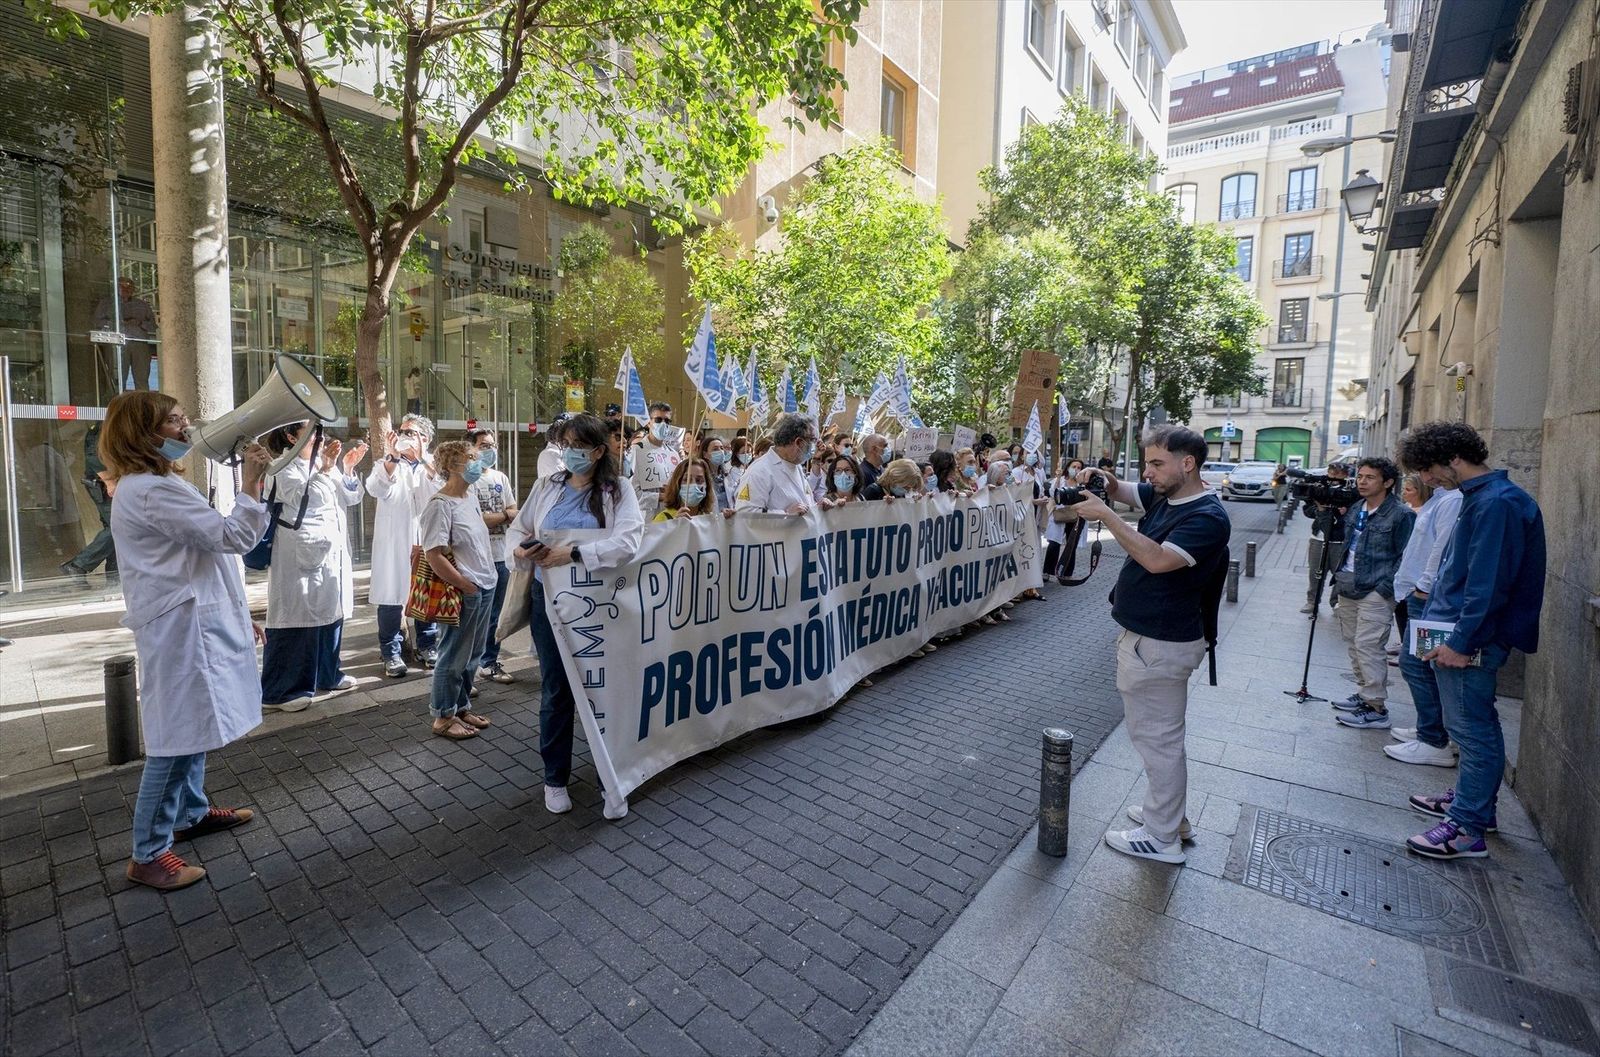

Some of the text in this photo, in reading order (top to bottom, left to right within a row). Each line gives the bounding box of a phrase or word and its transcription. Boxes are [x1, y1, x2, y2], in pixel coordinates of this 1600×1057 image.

[443, 271, 555, 306] de Sanidad
[645, 467, 660, 482] 24
[647, 452, 667, 463] STOP
[638, 549, 721, 644] POR
[729, 541, 788, 613] UN
[800, 523, 911, 602] ESTATUTO
[967, 504, 1009, 550] PARA
[638, 602, 836, 742] PROFESIÓN
[838, 582, 920, 661] MÉDICA
[925, 577, 936, 621] Y
